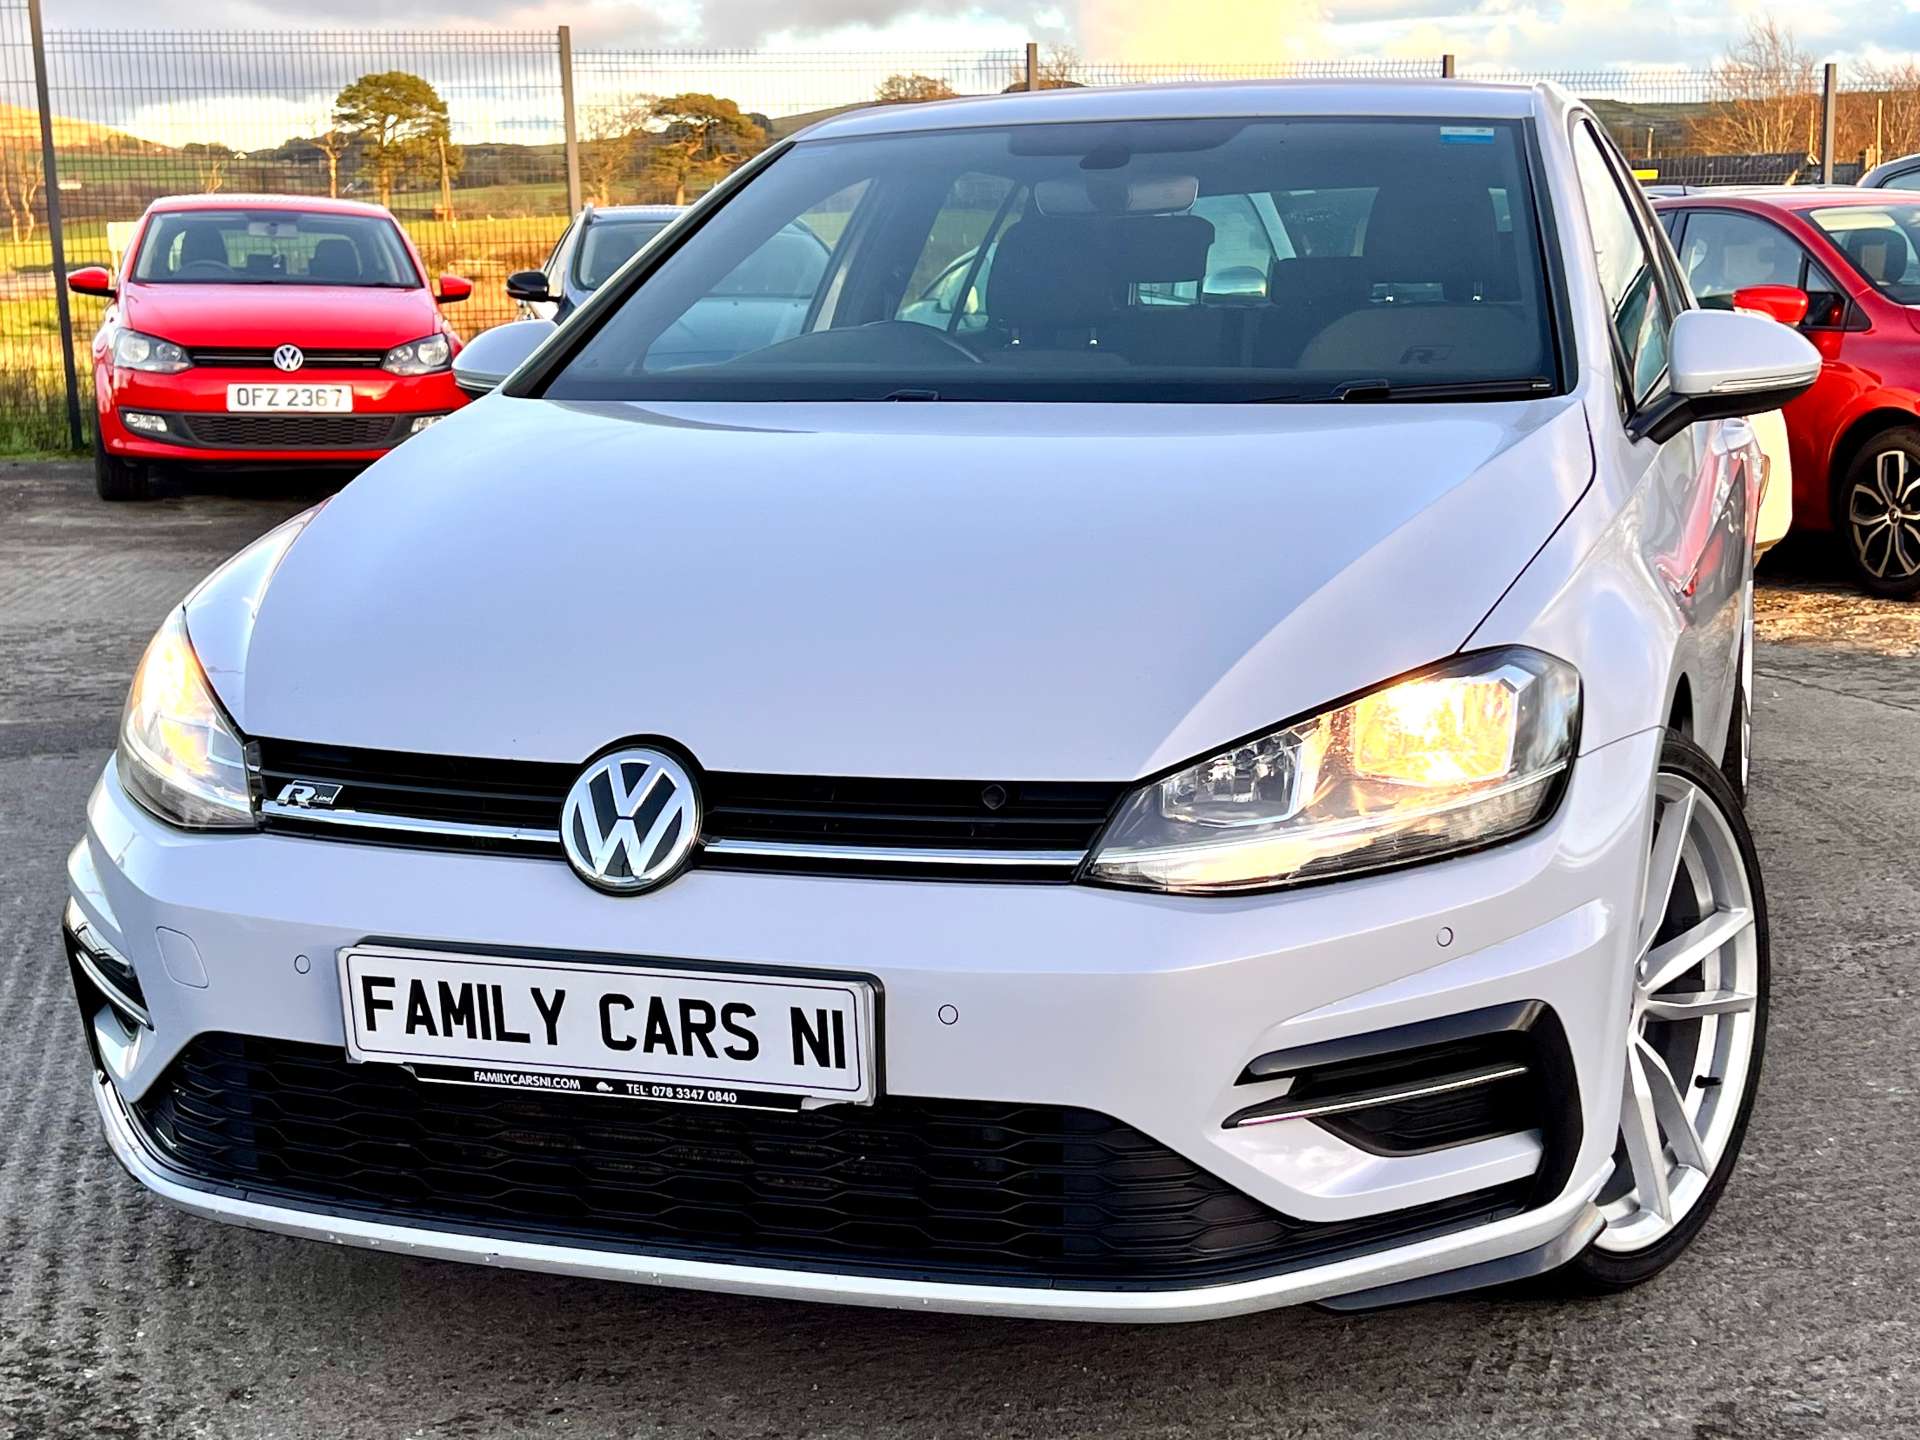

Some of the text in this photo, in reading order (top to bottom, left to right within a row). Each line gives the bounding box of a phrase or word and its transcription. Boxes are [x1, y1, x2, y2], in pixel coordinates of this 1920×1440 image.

[237, 388, 342, 407] OFZ 2367
[361, 975, 847, 1069] FAMILY CARS NI
[474, 1071, 737, 1103] FAMILYCARSNI.COM TEL: 078 3347 0840
